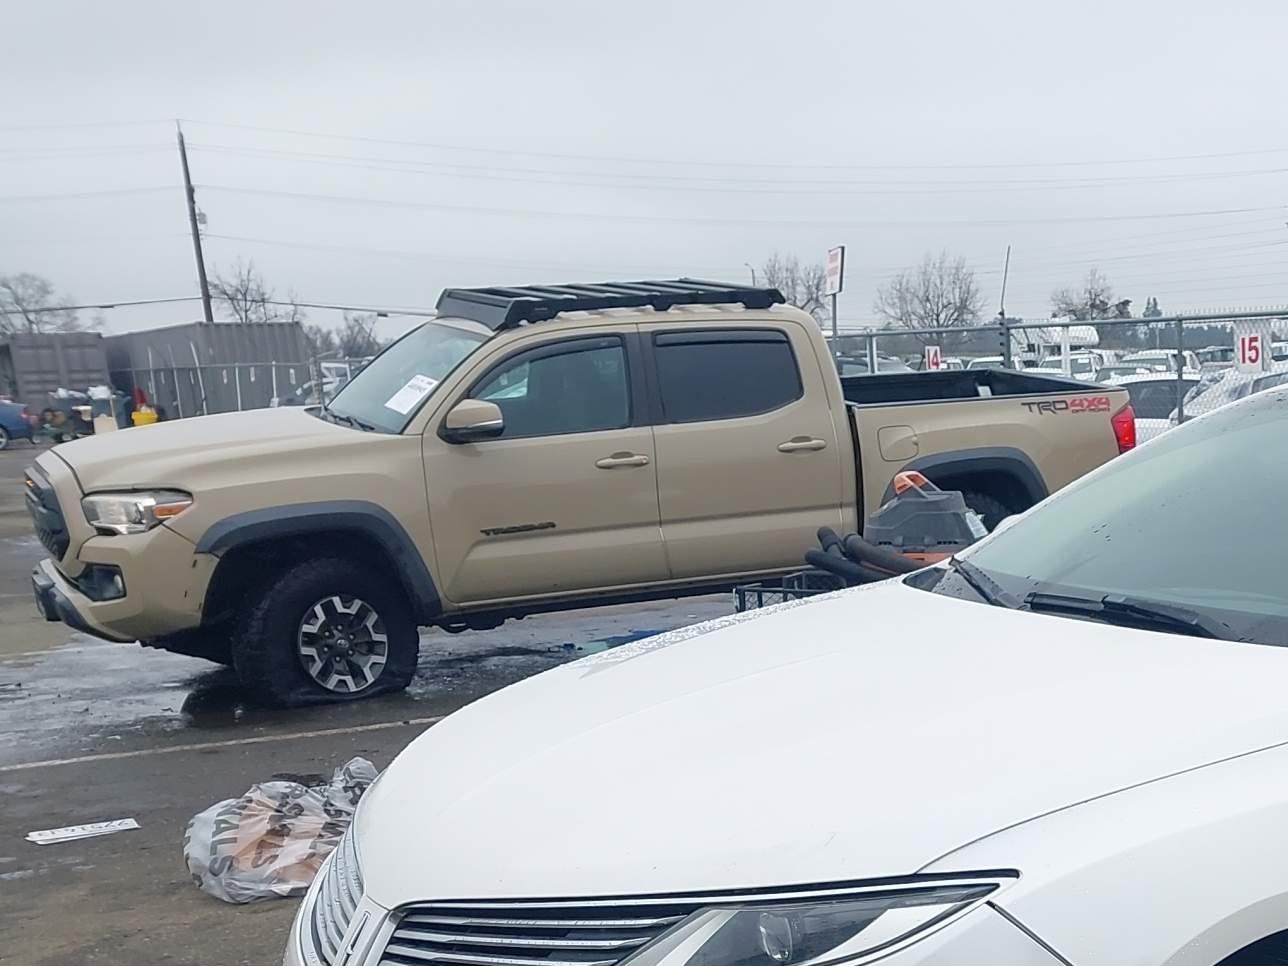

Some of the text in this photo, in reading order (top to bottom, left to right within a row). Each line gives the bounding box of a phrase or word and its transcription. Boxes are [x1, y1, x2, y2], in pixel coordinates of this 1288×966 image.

[926, 347, 940, 370] 14
[1241, 335, 1260, 365] 15
[1021, 399, 1069, 416] TRD
